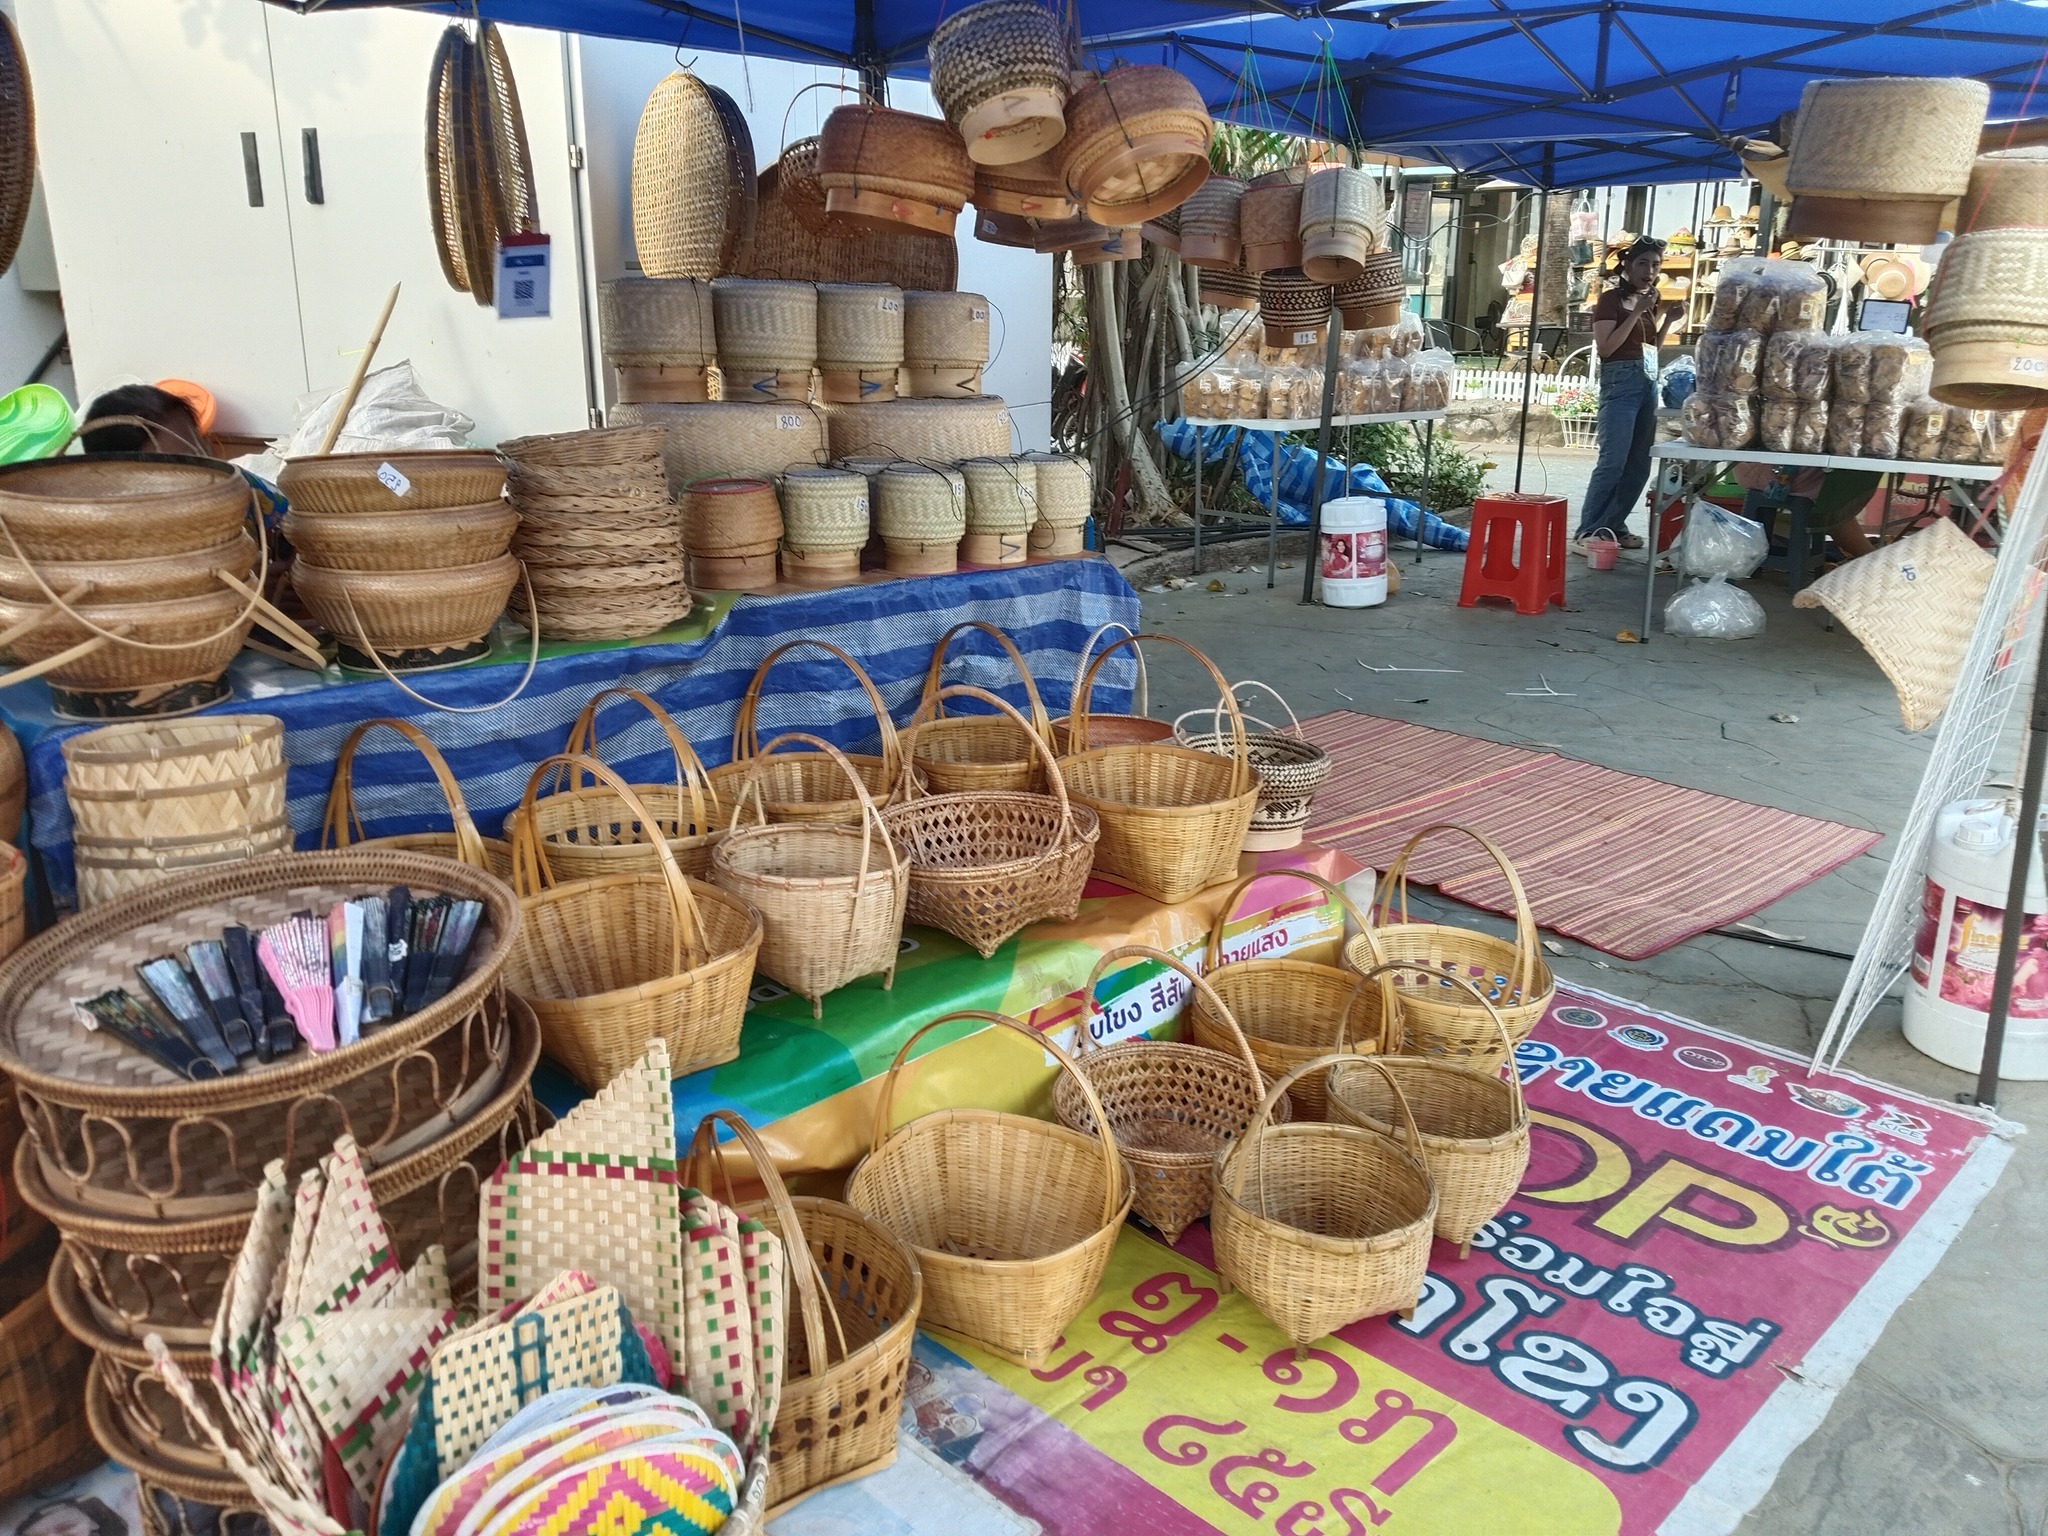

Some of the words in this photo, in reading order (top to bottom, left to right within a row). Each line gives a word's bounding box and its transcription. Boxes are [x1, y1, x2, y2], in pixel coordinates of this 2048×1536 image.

[2012, 356, 2046, 372] 200
[780, 415, 802, 430] 800
[1879, 1120, 1920, 1140] KICE
[1527, 1112, 1791, 1245] OP
